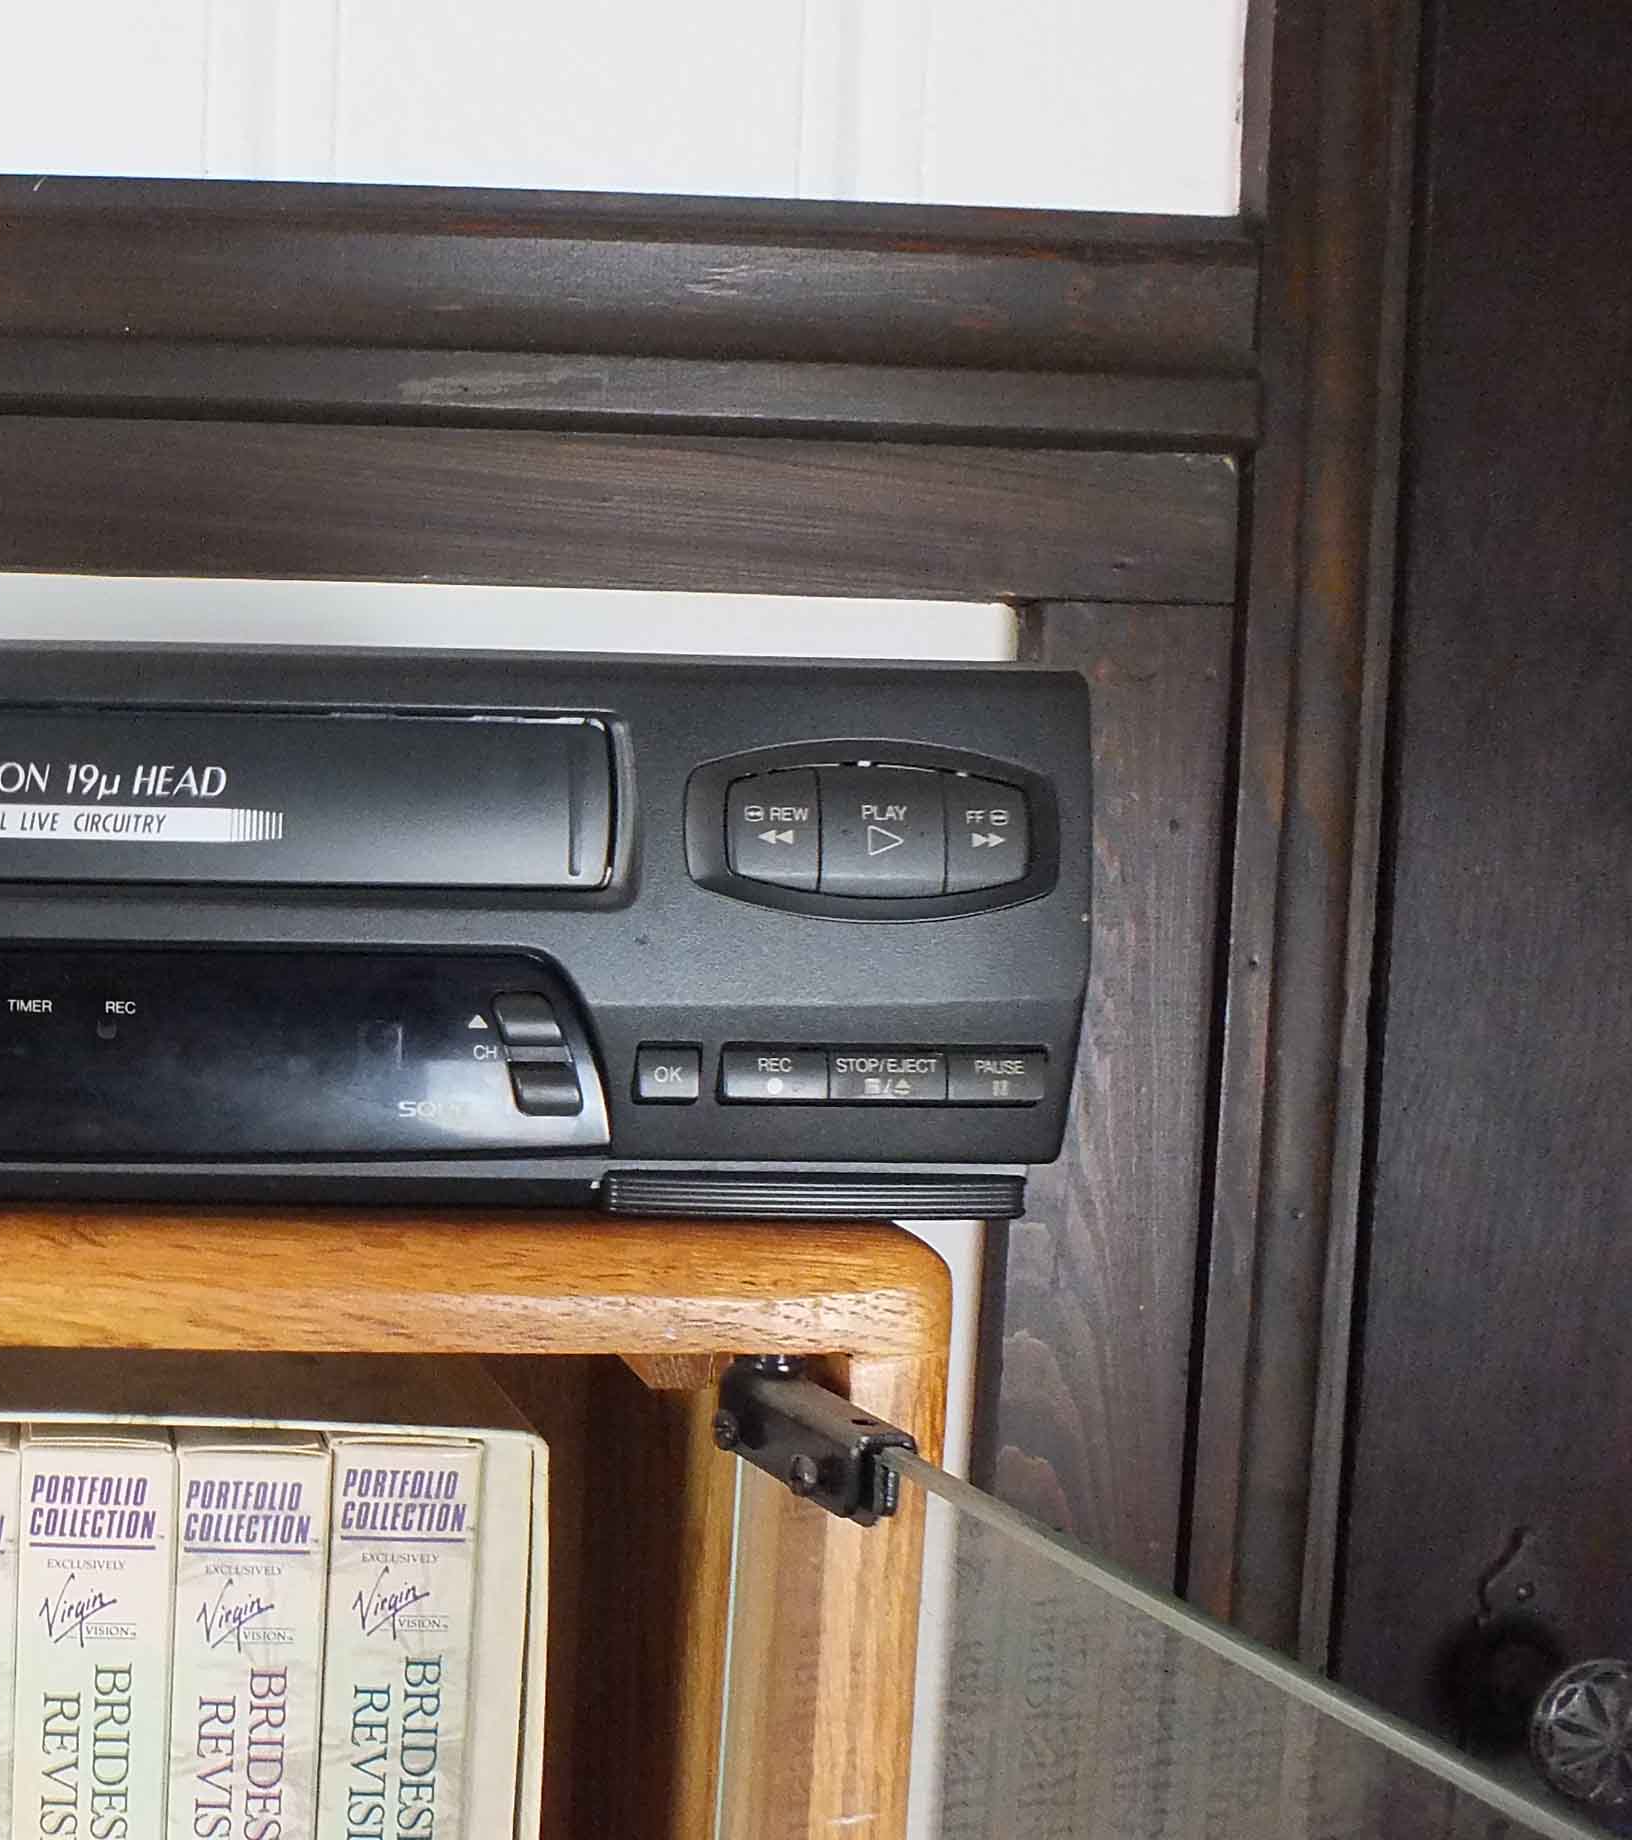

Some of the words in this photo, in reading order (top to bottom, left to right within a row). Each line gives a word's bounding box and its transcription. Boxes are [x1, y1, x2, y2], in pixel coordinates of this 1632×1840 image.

[133, 765, 228, 798] HEAD
[769, 806, 810, 822] REW
[861, 804, 907, 822] PLAY
[965, 810, 985, 825] FF
[20, 812, 60, 832] LIVE
[73, 812, 168, 834] CIRCUITRY
[8, 999, 54, 1013] TIMER
[105, 1000, 137, 1015] REC
[473, 1045, 497, 1060] CH
[758, 1057, 793, 1074] REC
[836, 1058, 938, 1075] STOP/EJECT
[974, 1060, 1026, 1075] PAUSE
[654, 1066, 682, 1084] OK
[30, 1474, 148, 1507] PORTFOLIO
[342, 1468, 459, 1500] PORTFOLIO
[185, 1480, 303, 1511] PORTFOLIO
[47, 1558, 127, 1571] EXCLUSIVELY
[361, 1552, 440, 1564] EXCLUSIVELY
[205, 1564, 283, 1576] EXCLUSIVELY
[39, 1572, 117, 1648] Virgin
[352, 1566, 430, 1640] Virgin
[196, 1578, 274, 1652] Virgin
